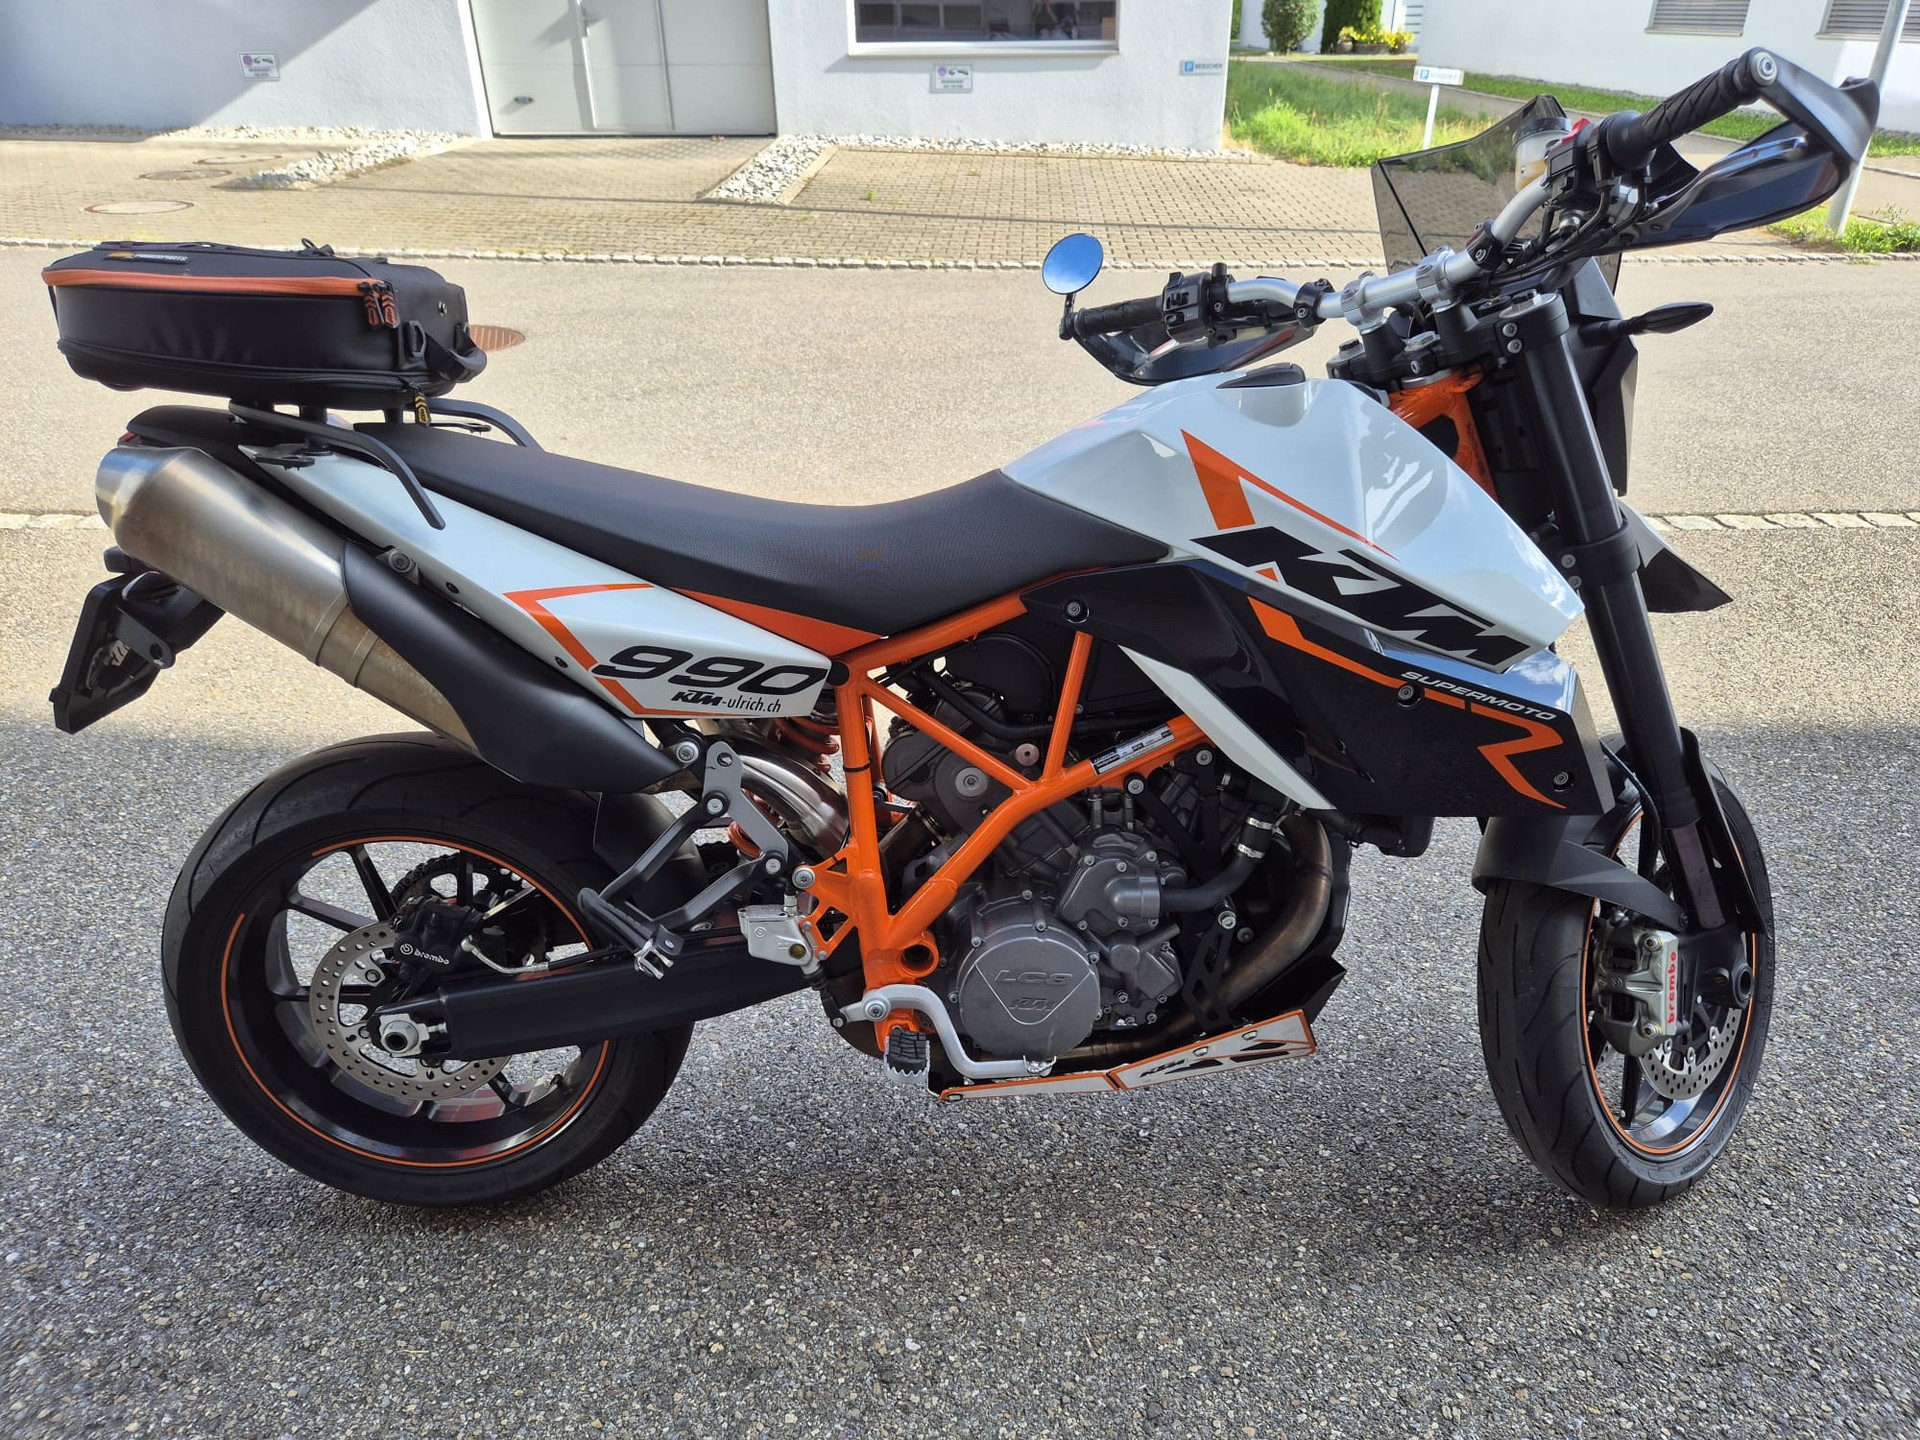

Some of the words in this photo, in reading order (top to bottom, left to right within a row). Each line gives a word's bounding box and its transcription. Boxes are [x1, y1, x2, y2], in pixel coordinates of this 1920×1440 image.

[1189, 525, 1531, 666] KTM
[591, 645, 828, 695] 990
[1400, 670, 1557, 720] SUPERMOTO
[670, 689, 782, 713] KTM-ulrich.ch
[414, 948, 450, 965] brembo
[1666, 951, 1676, 1024] brembo
